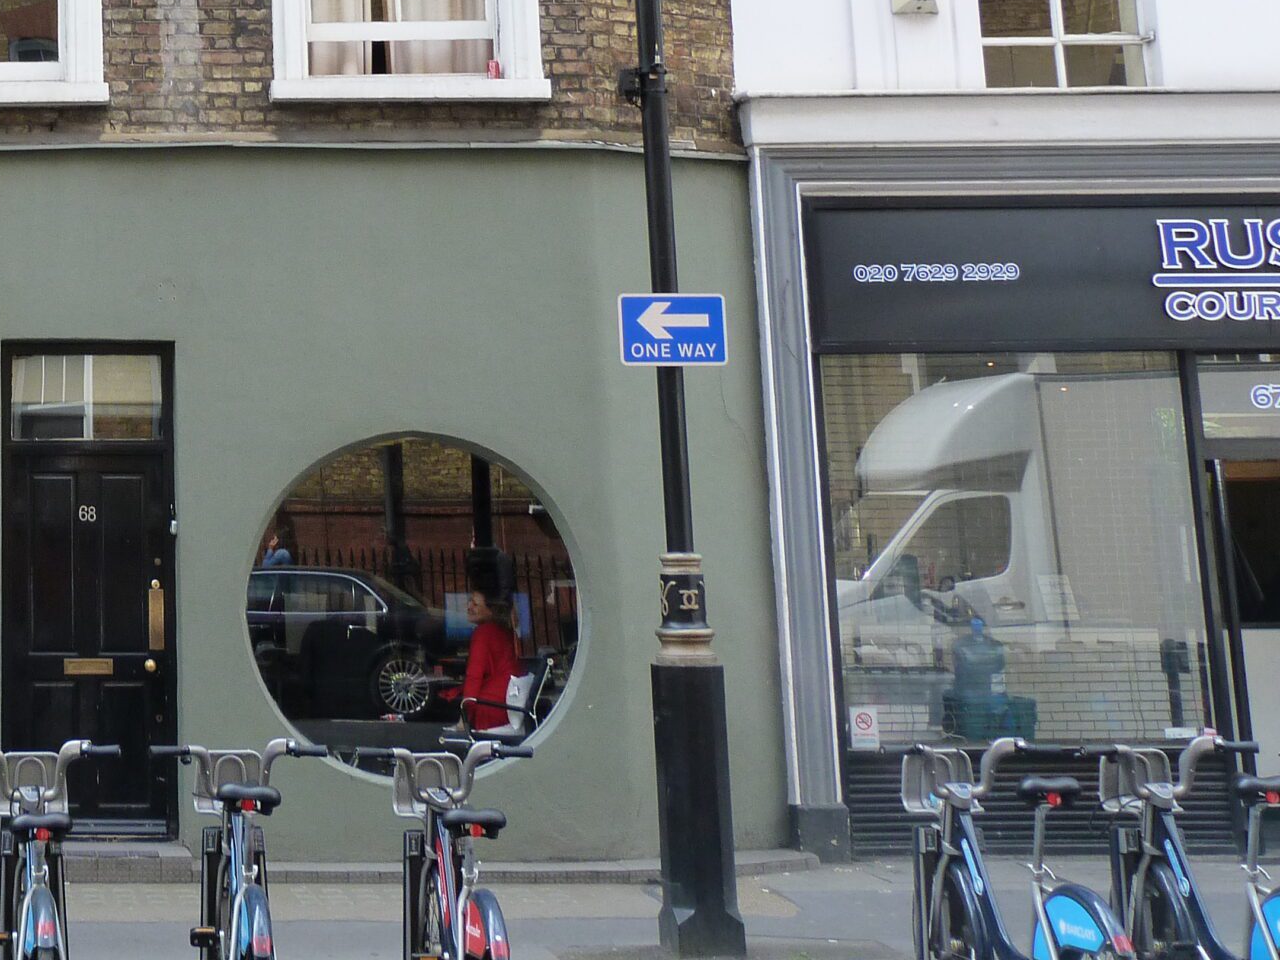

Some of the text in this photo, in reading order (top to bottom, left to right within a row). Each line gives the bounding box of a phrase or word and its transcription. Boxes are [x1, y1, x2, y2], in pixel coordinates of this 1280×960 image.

[1156, 219, 1280, 269] RU
[853, 262, 1020, 283] 020 7629 2929
[1165, 291, 1280, 321] COUR
[631, 342, 717, 358] ONE WAY
[78, 505, 97, 521] 68
